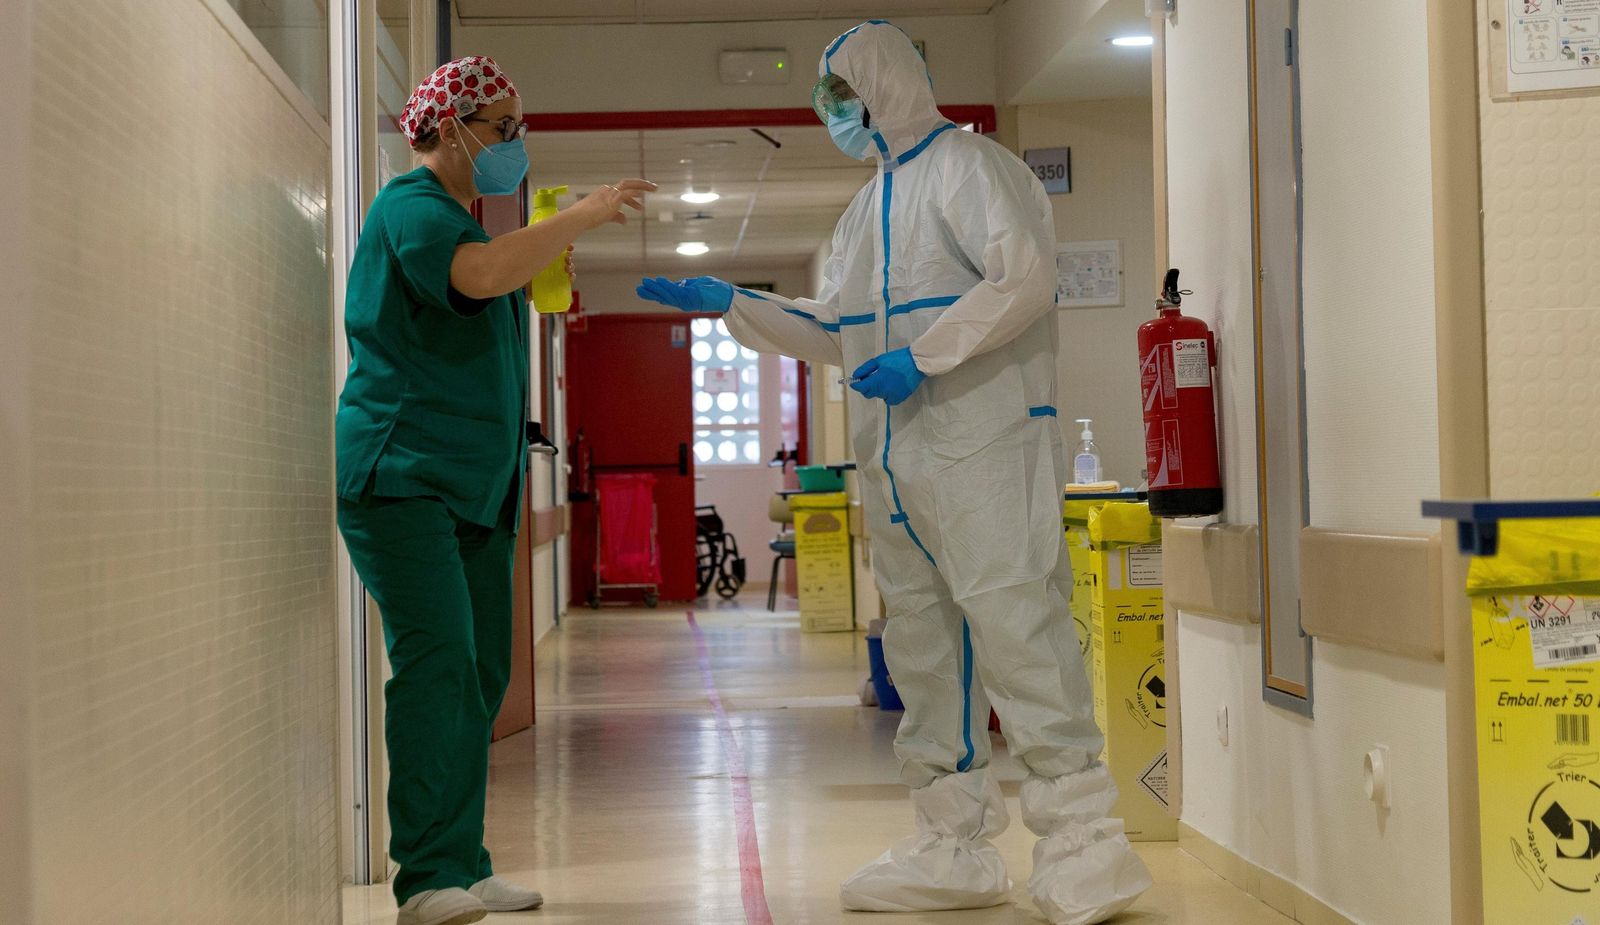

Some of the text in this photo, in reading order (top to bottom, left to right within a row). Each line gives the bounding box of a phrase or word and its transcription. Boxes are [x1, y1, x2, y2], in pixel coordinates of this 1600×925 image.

[1175, 341, 1198, 351] Sinelec
[1117, 612, 1164, 622] Embal.net
[1530, 615, 1572, 630] UN 3291
[1136, 692, 1152, 719] Traiter
[1498, 691, 1566, 707] Embal.net
[1573, 693, 1593, 708] 50
[1556, 771, 1587, 783] Trier
[1527, 827, 1548, 874] Traiter
